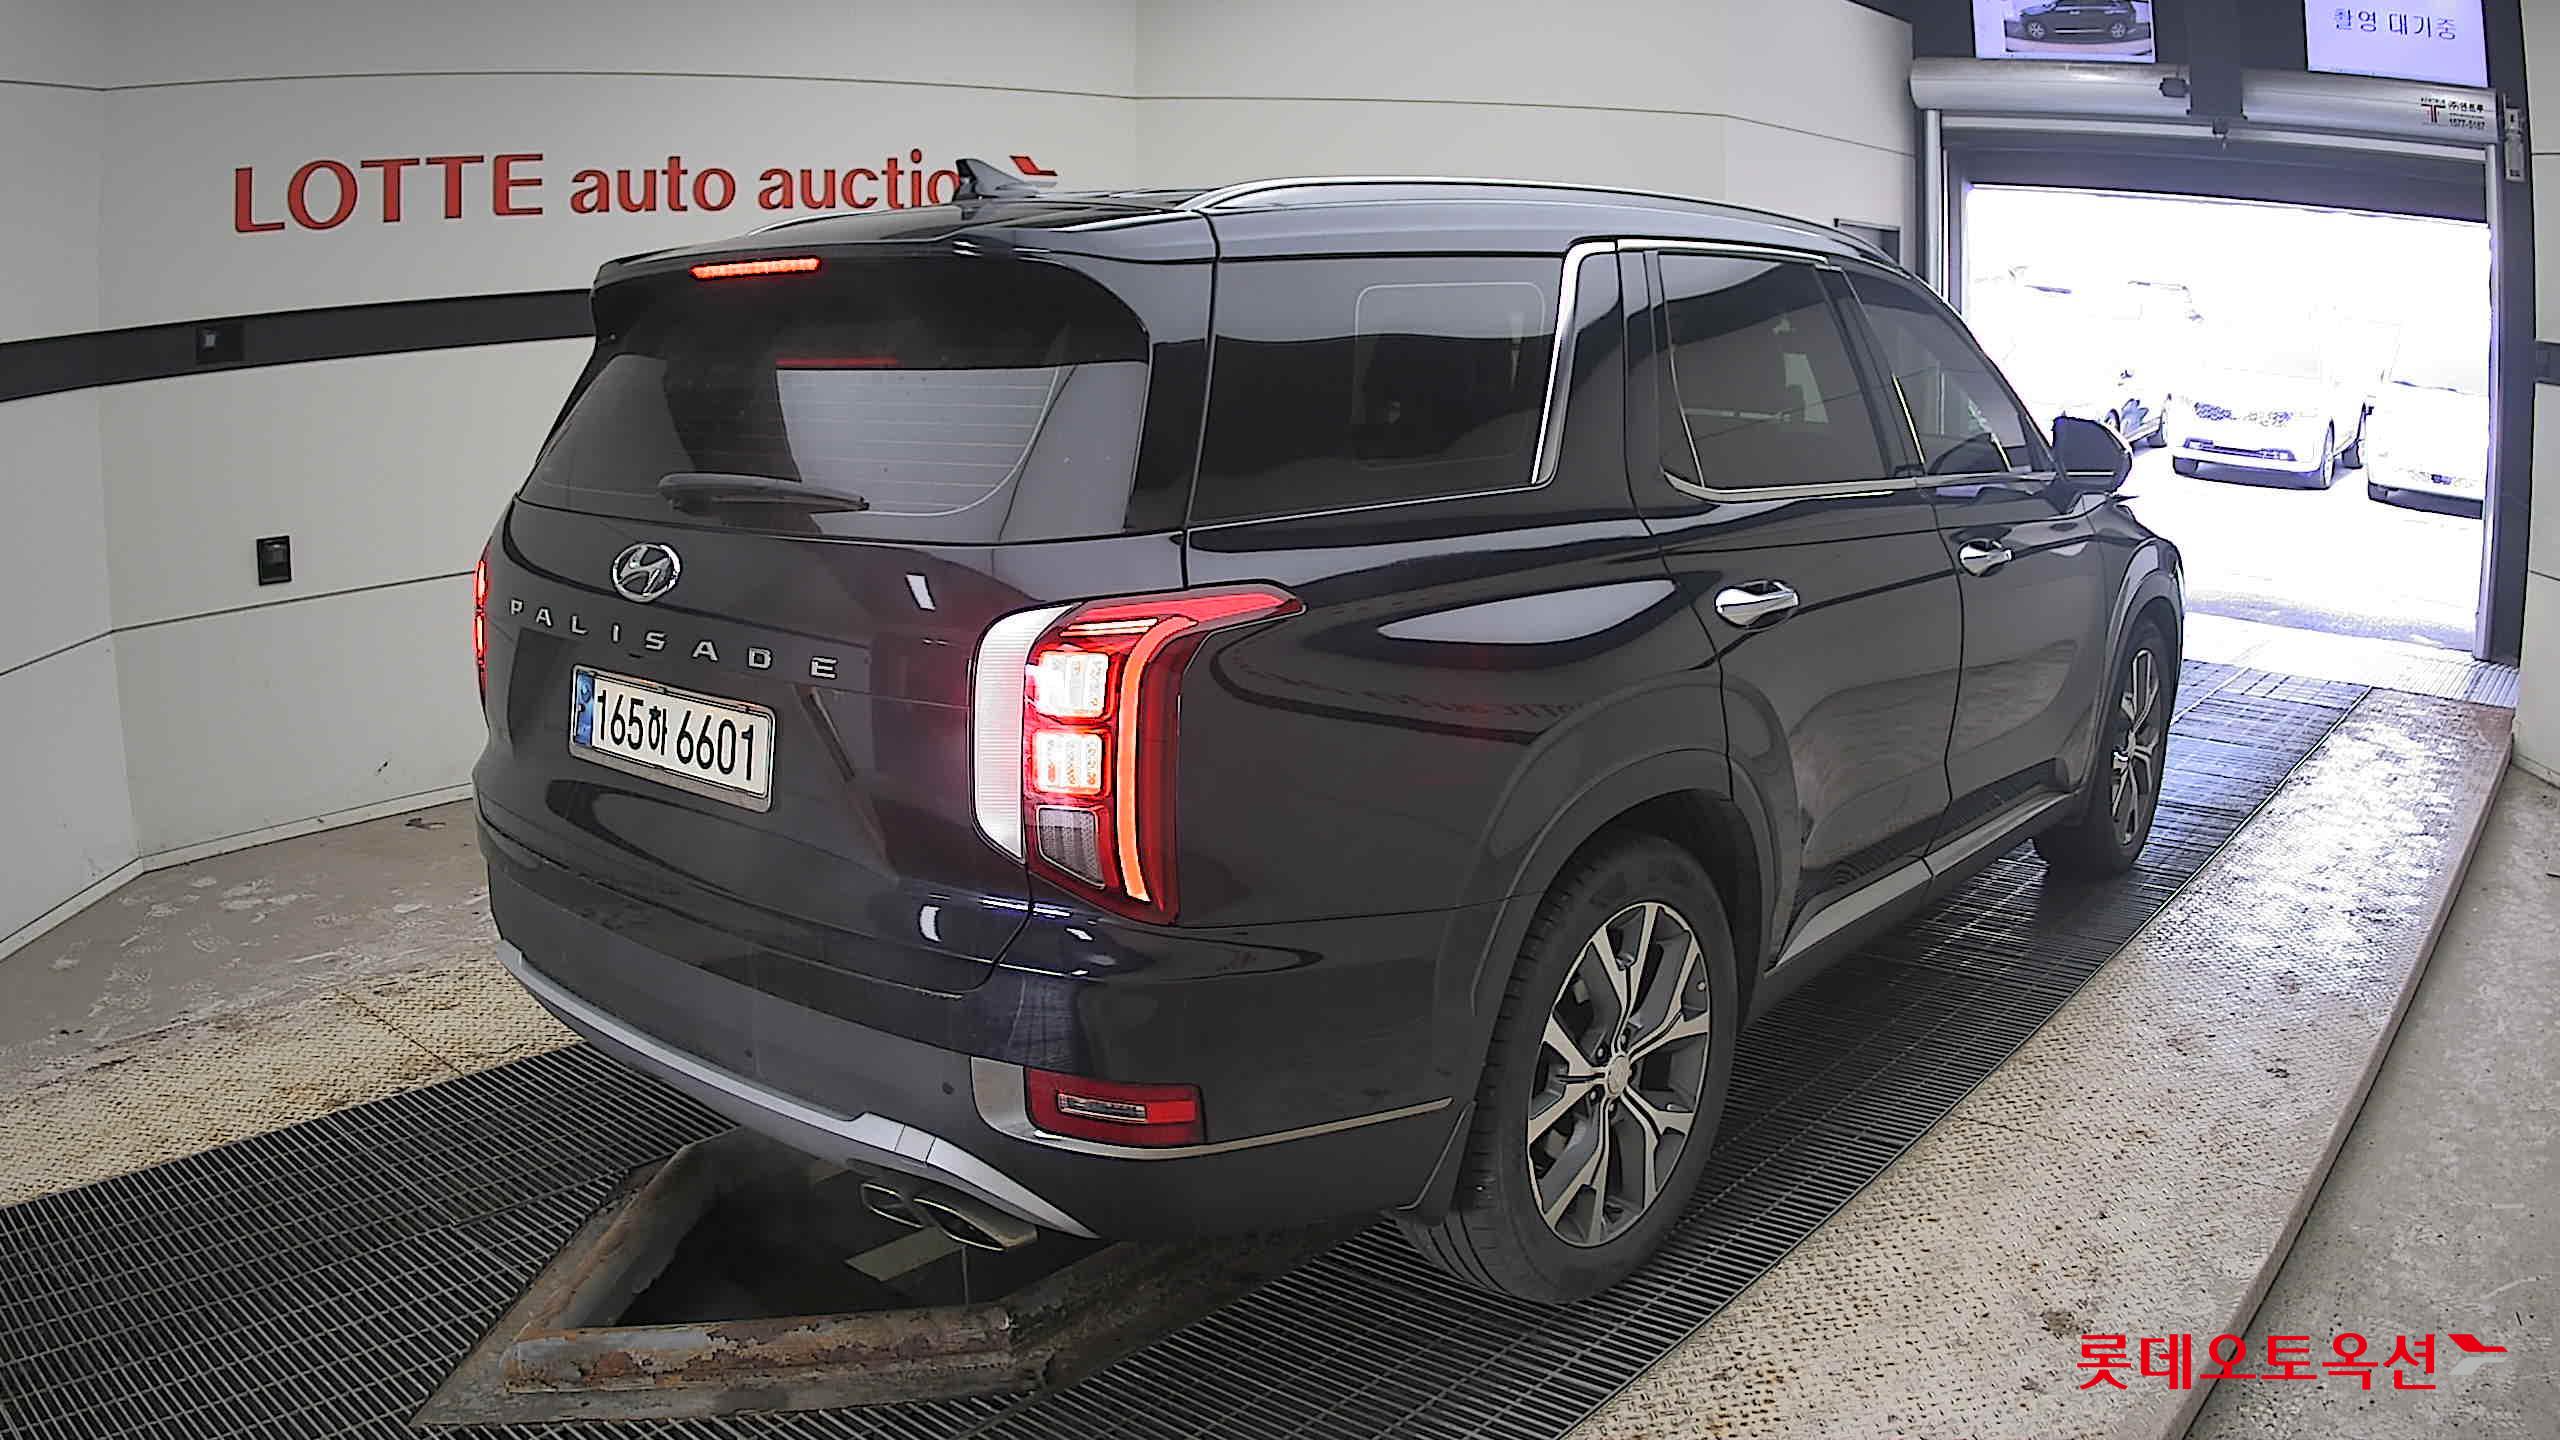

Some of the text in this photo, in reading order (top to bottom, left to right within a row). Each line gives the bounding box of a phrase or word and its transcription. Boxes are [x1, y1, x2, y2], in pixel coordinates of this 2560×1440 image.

[2389, 13, 2457, 40] 대기중
[234, 148, 961, 233] LOTTE auto auctio
[509, 598, 839, 680] PALISADE
[597, 689, 754, 781] 165하 6601
